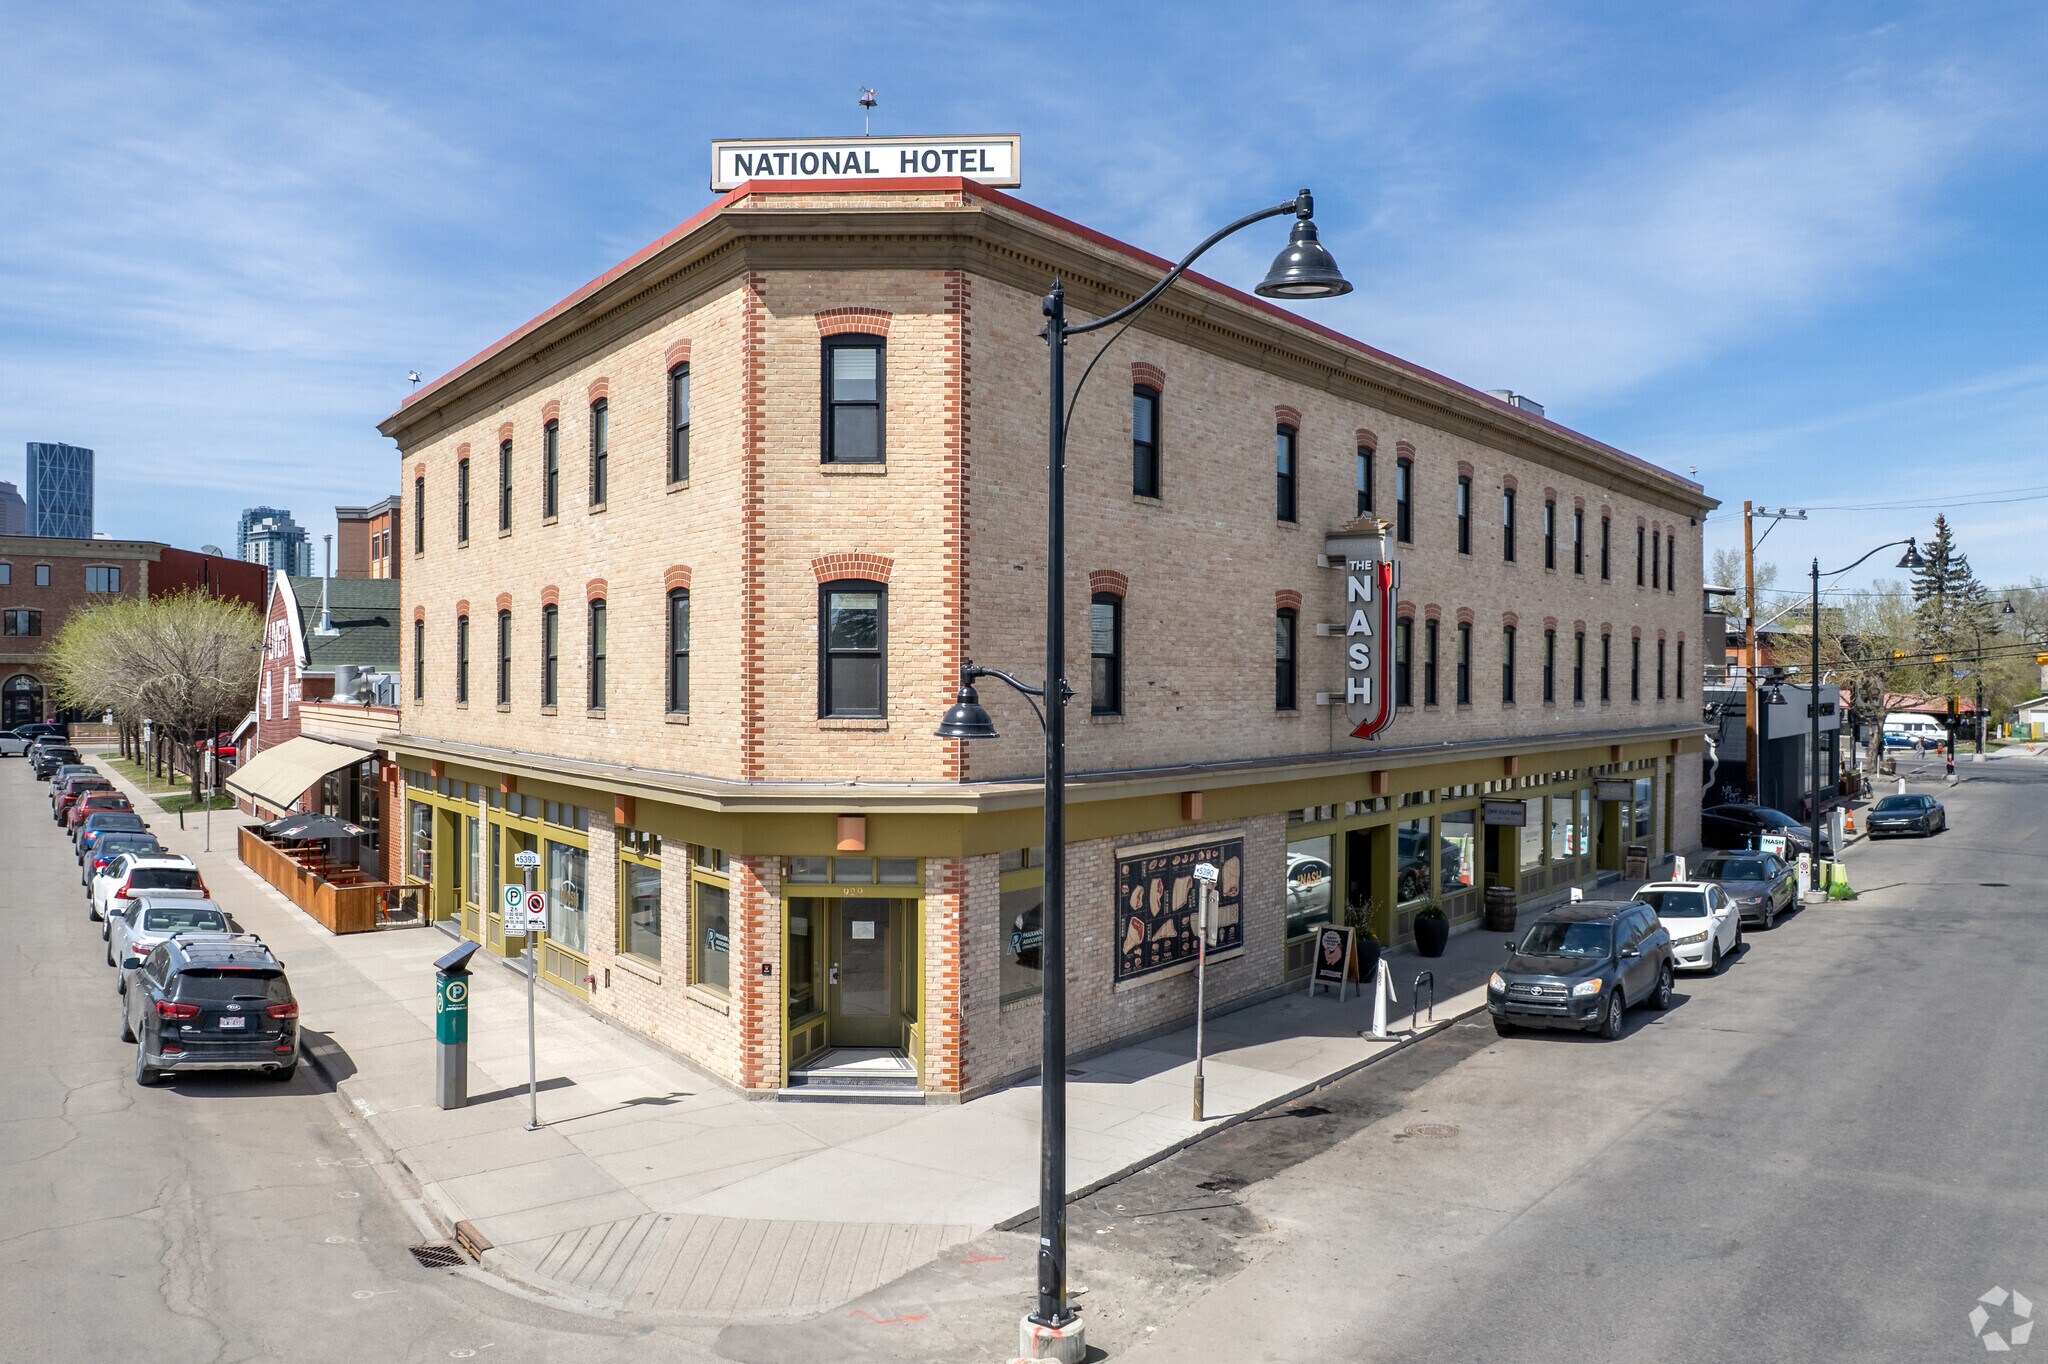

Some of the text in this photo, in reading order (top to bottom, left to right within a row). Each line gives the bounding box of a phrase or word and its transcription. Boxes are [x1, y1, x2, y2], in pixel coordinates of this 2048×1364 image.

[735, 149, 995, 176] NATIONAL HOTEL
[1349, 560, 1372, 571] THE
[1347, 575, 1372, 704] NASH
[1765, 838, 1784, 846] NASH
[519, 855, 536, 864] 5393
[1198, 867, 1214, 877] 5390
[1300, 870, 1322, 886] NASH
[510, 891, 518, 902] P
[843, 887, 863, 896] 929
[452, 985, 463, 998] P
